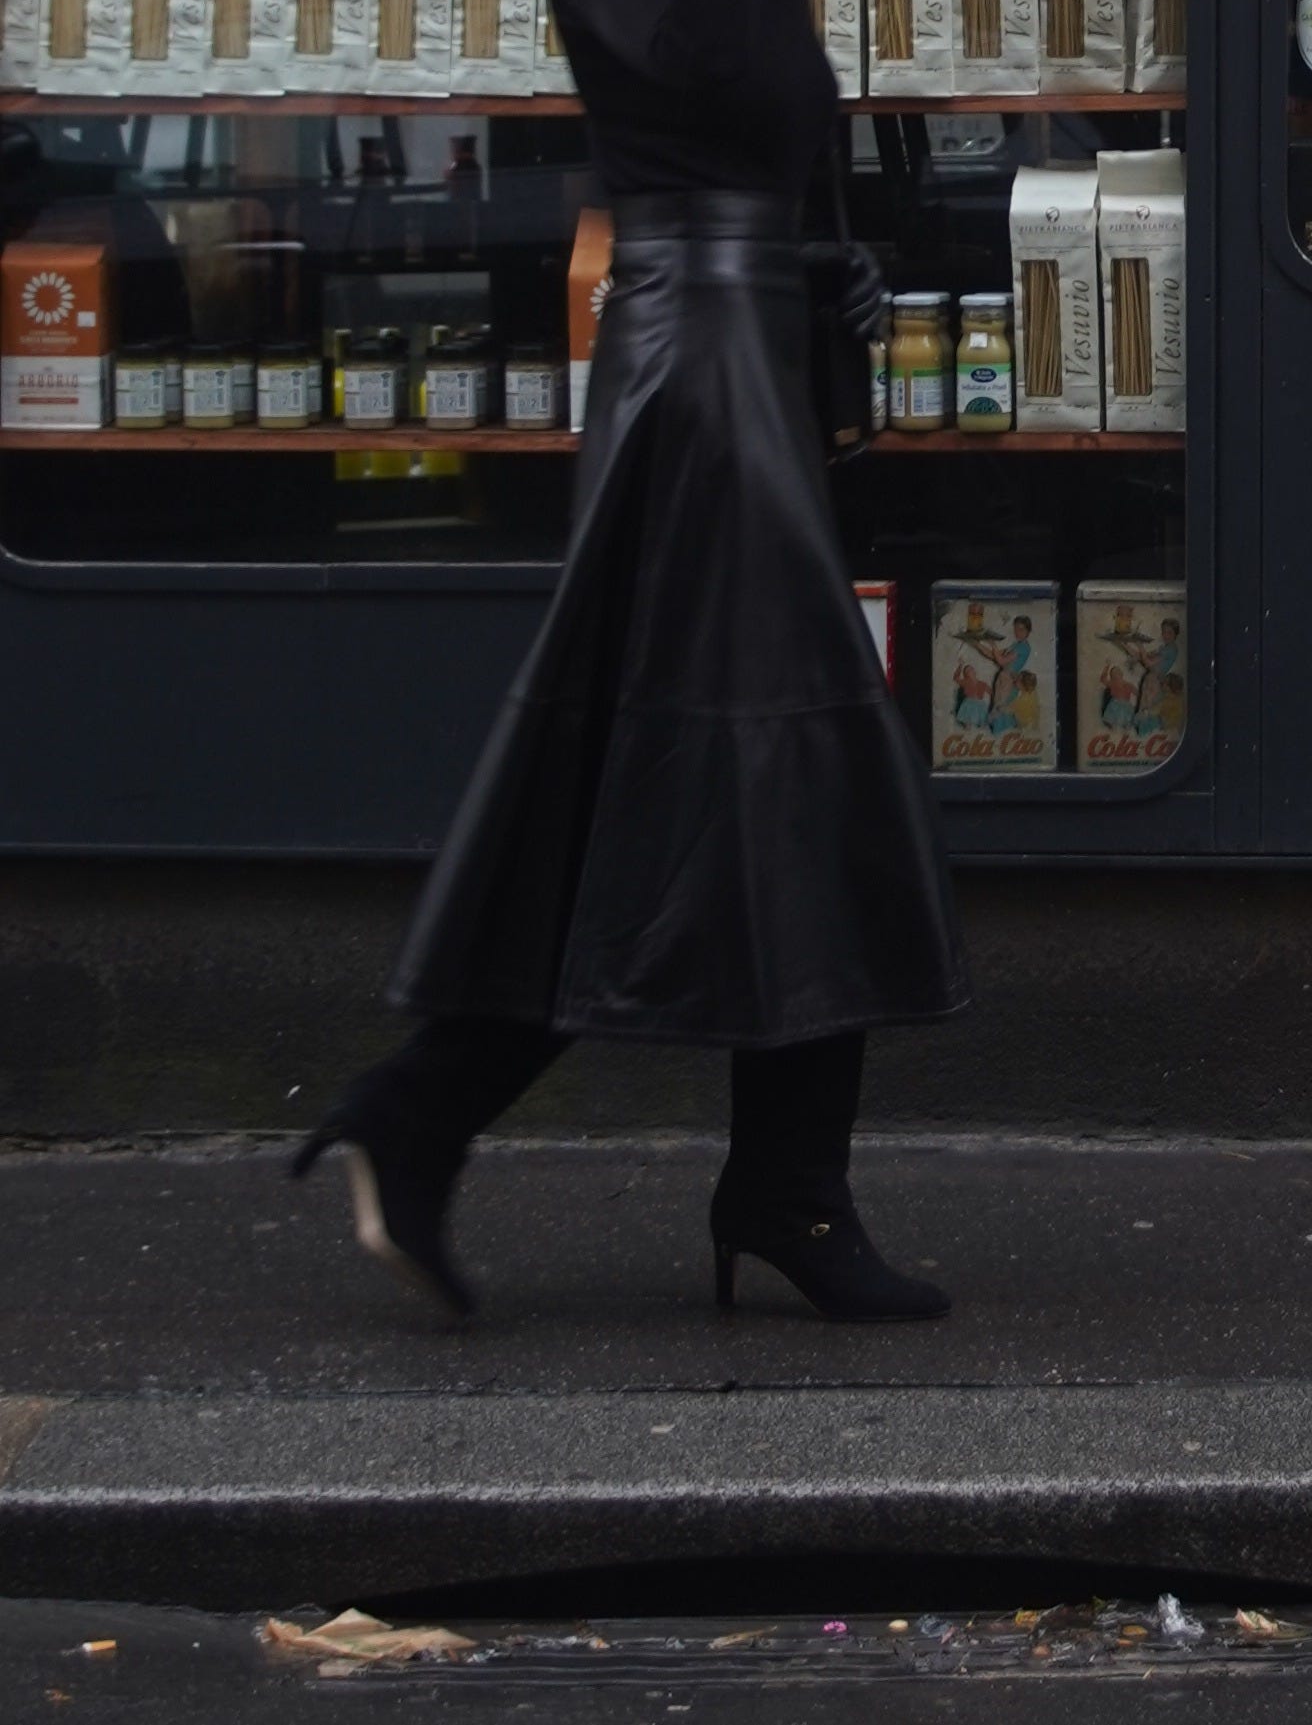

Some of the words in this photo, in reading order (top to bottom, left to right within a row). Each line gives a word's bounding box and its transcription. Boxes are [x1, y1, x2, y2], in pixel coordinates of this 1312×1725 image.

[1065, 279, 1091, 376] Vesuvio
[1155, 277, 1182, 376] Vesuvio
[941, 733, 995, 758] Cola
[999, 731, 1044, 756] Cao
[1087, 733, 1138, 759] Cola
